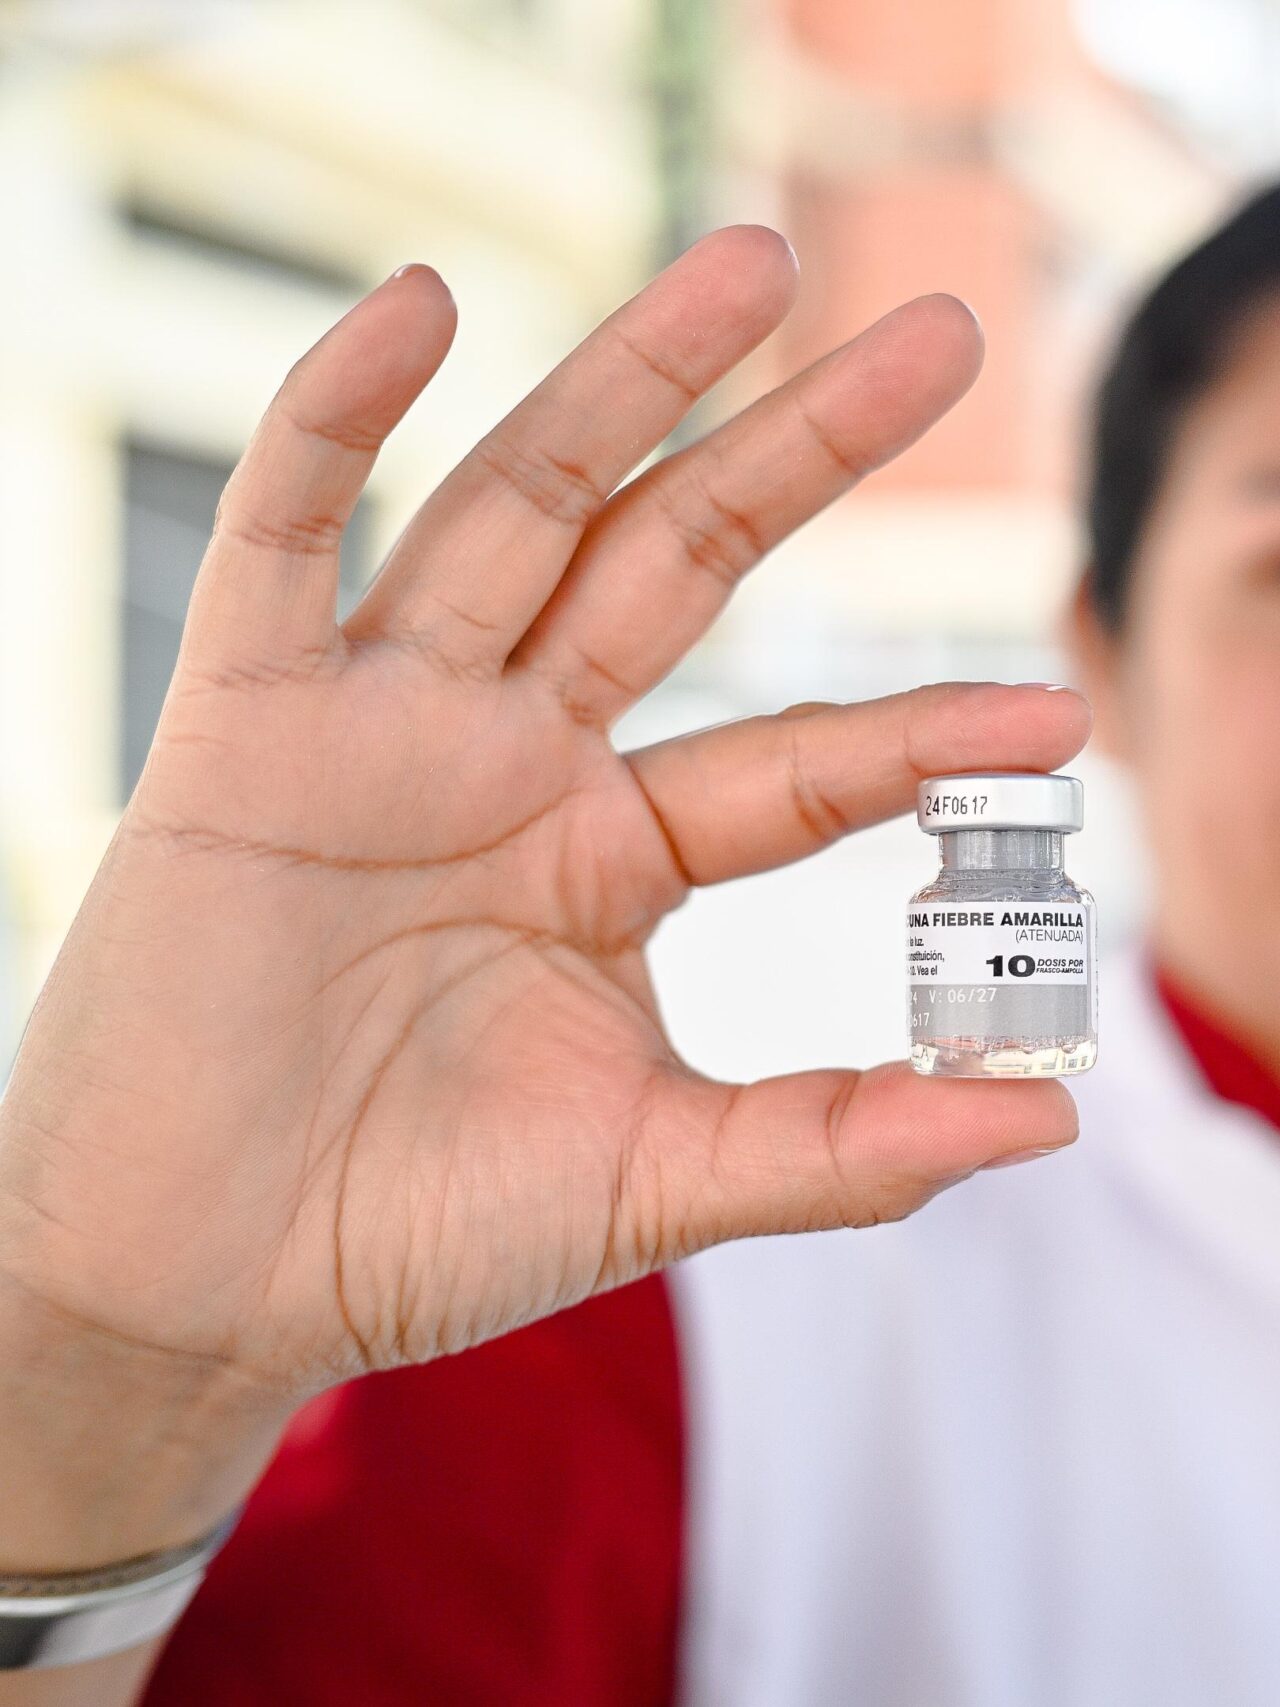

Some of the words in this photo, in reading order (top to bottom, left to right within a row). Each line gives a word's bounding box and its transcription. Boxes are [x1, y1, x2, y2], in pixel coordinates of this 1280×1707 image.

[925, 795, 987, 815] 24F0617
[933, 912, 994, 926] FIEBRE
[1000, 912, 1083, 926] AMARILLA
[1015, 929, 1083, 943] (ATENUADA)
[916, 965, 929, 975] Vea
[930, 964, 938, 975] el
[985, 954, 1035, 977] 10
[1037, 958, 1066, 966] DOSIS
[1068, 959, 1083, 967] POR
[928, 988, 942, 1003] V:
[947, 987, 997, 1003] 06/27
